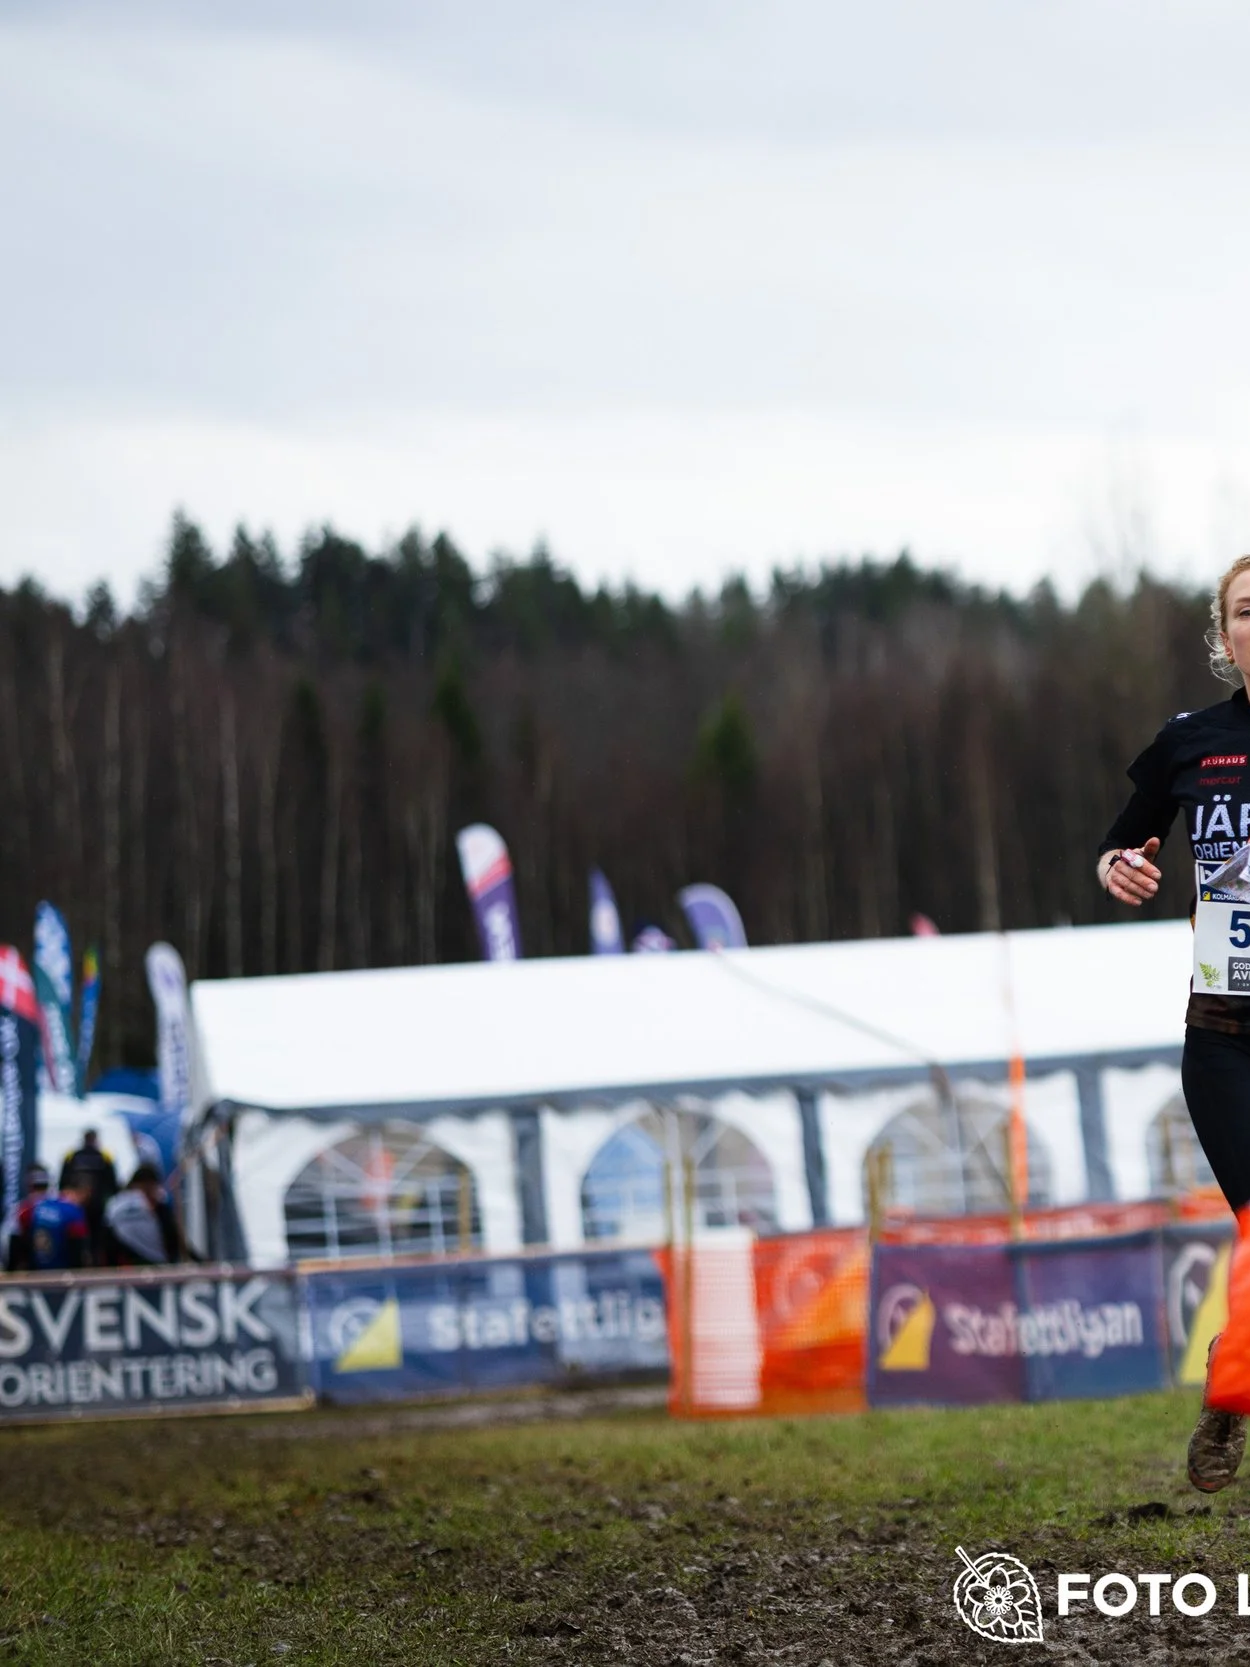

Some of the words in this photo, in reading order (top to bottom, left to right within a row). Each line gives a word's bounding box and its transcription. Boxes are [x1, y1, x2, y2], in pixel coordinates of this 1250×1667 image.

[1194, 841, 1247, 860] ORIEN
[0, 1277, 272, 1357] SVENSK
[427, 1289, 664, 1352] Stafettlig
[0, 1347, 279, 1407] ORIENTERING
